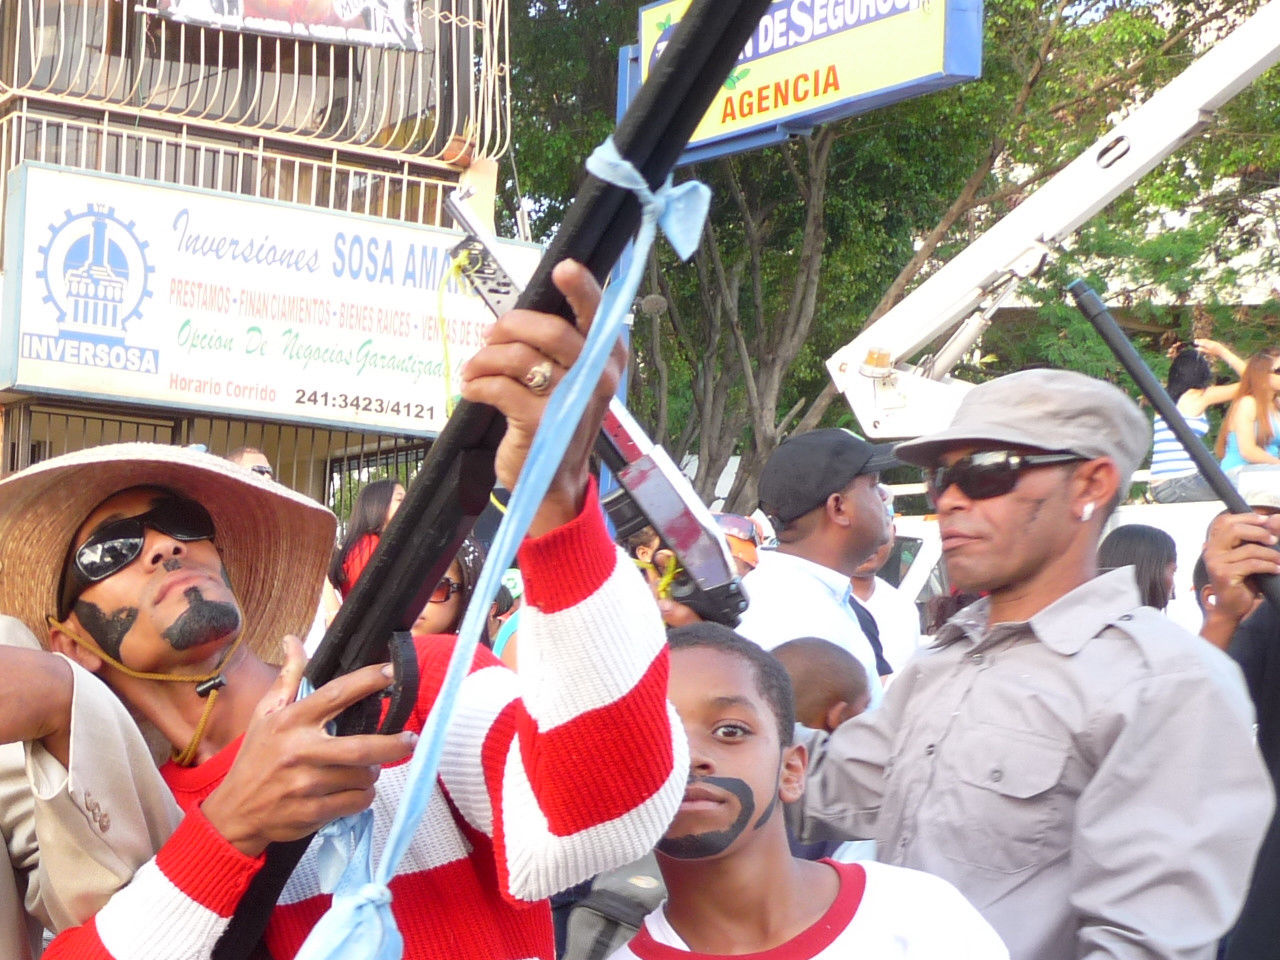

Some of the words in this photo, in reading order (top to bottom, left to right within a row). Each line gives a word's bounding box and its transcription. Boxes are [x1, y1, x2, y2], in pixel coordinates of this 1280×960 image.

[722, 64, 840, 124] AGENCIA
[173, 208, 320, 272] Inversiones
[332, 232, 395, 285] SOSA
[170, 278, 231, 315] PRESTAMOS
[339, 302, 374, 332] BIENES
[377, 307, 411, 338] RAICES
[460, 319, 471, 347] DE
[22, 334, 158, 374] INVERSOSA
[177, 318, 234, 356] Opcion
[245, 326, 269, 356] De
[282, 328, 352, 371] Negocios
[169, 373, 222, 397] Horario
[226, 380, 276, 403] Corrido
